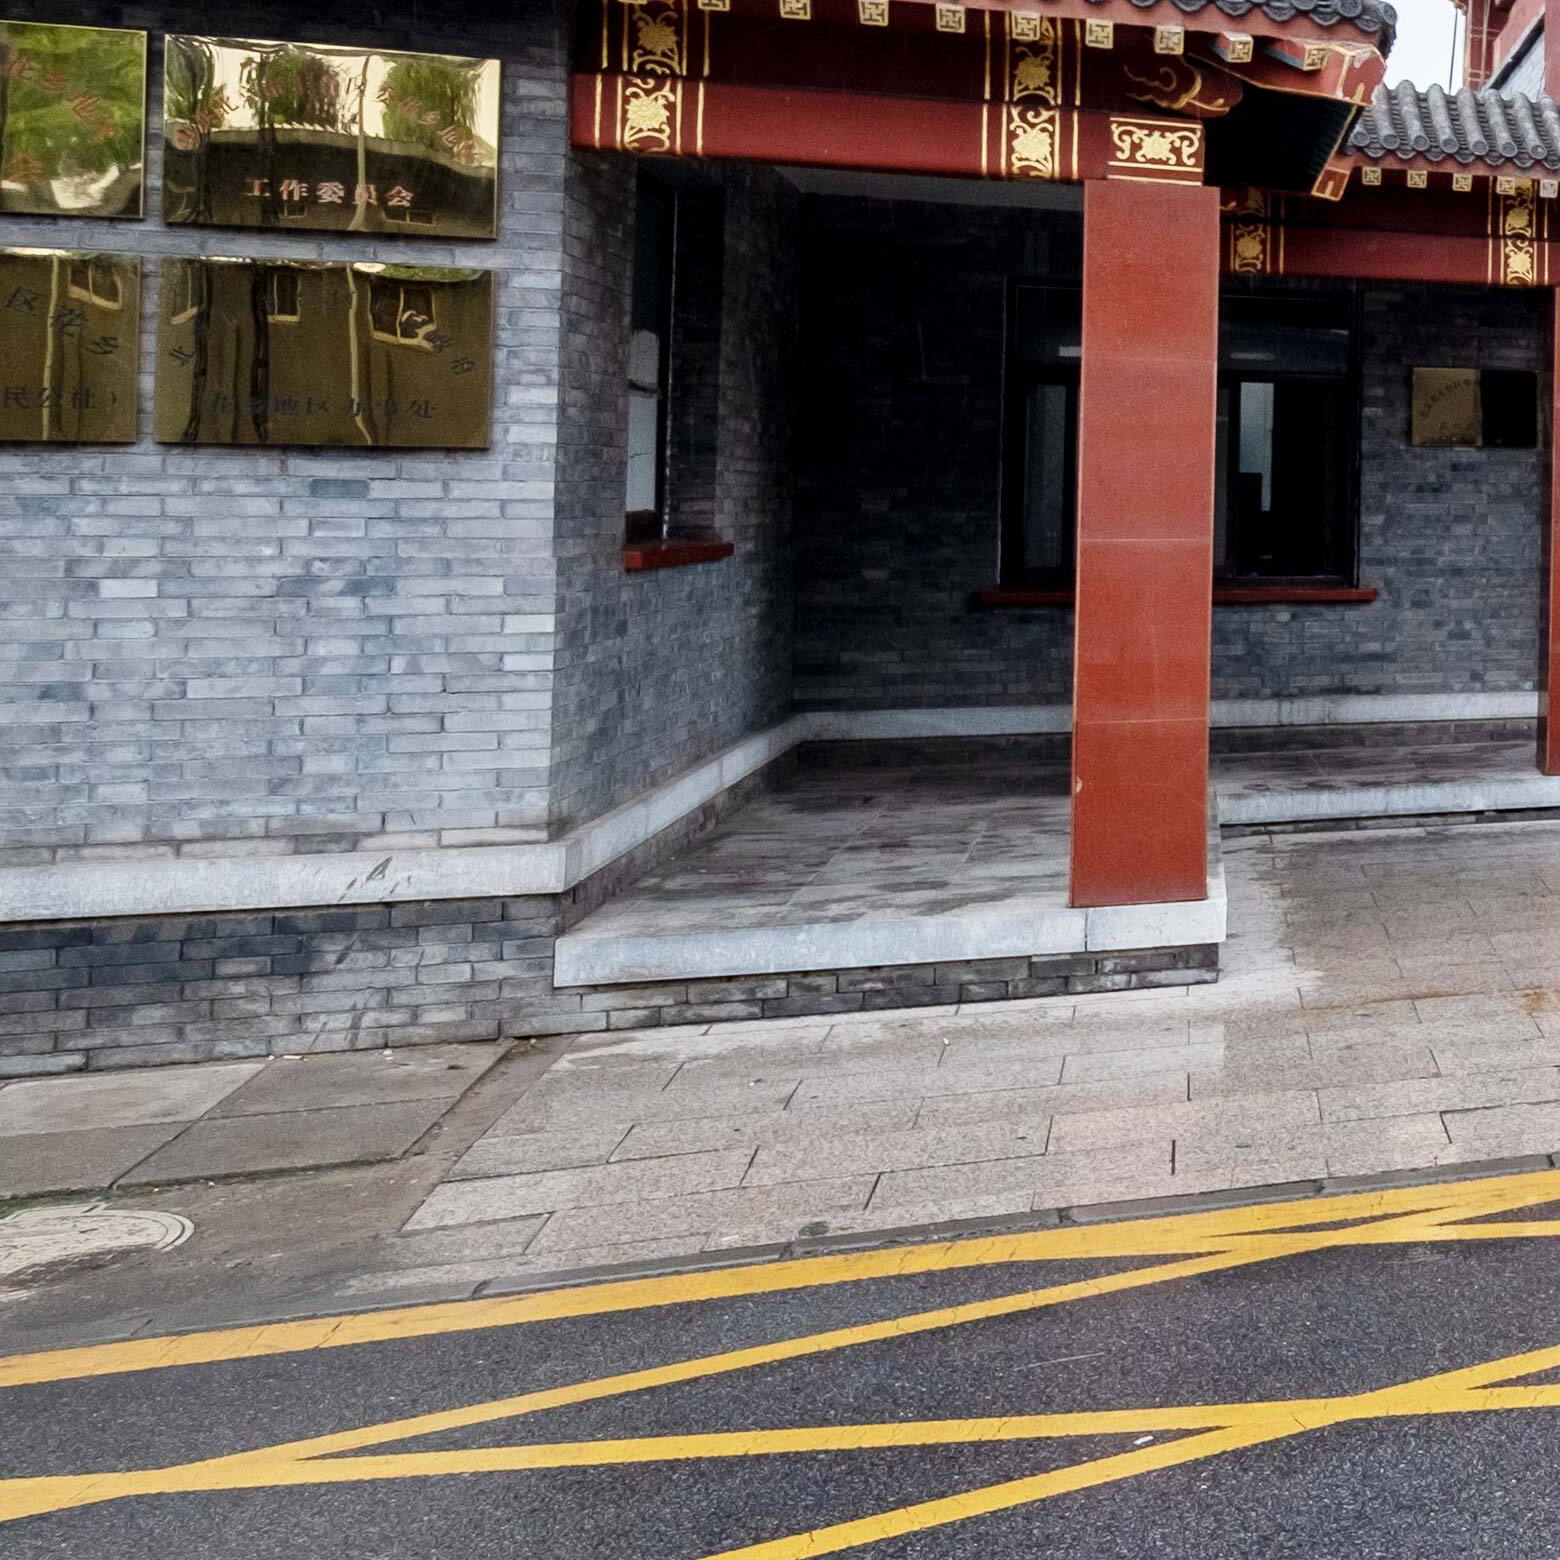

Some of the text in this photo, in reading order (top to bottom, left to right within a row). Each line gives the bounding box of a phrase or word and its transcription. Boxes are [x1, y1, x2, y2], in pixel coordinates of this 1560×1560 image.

[240, 177, 415, 208] 工作委员会
